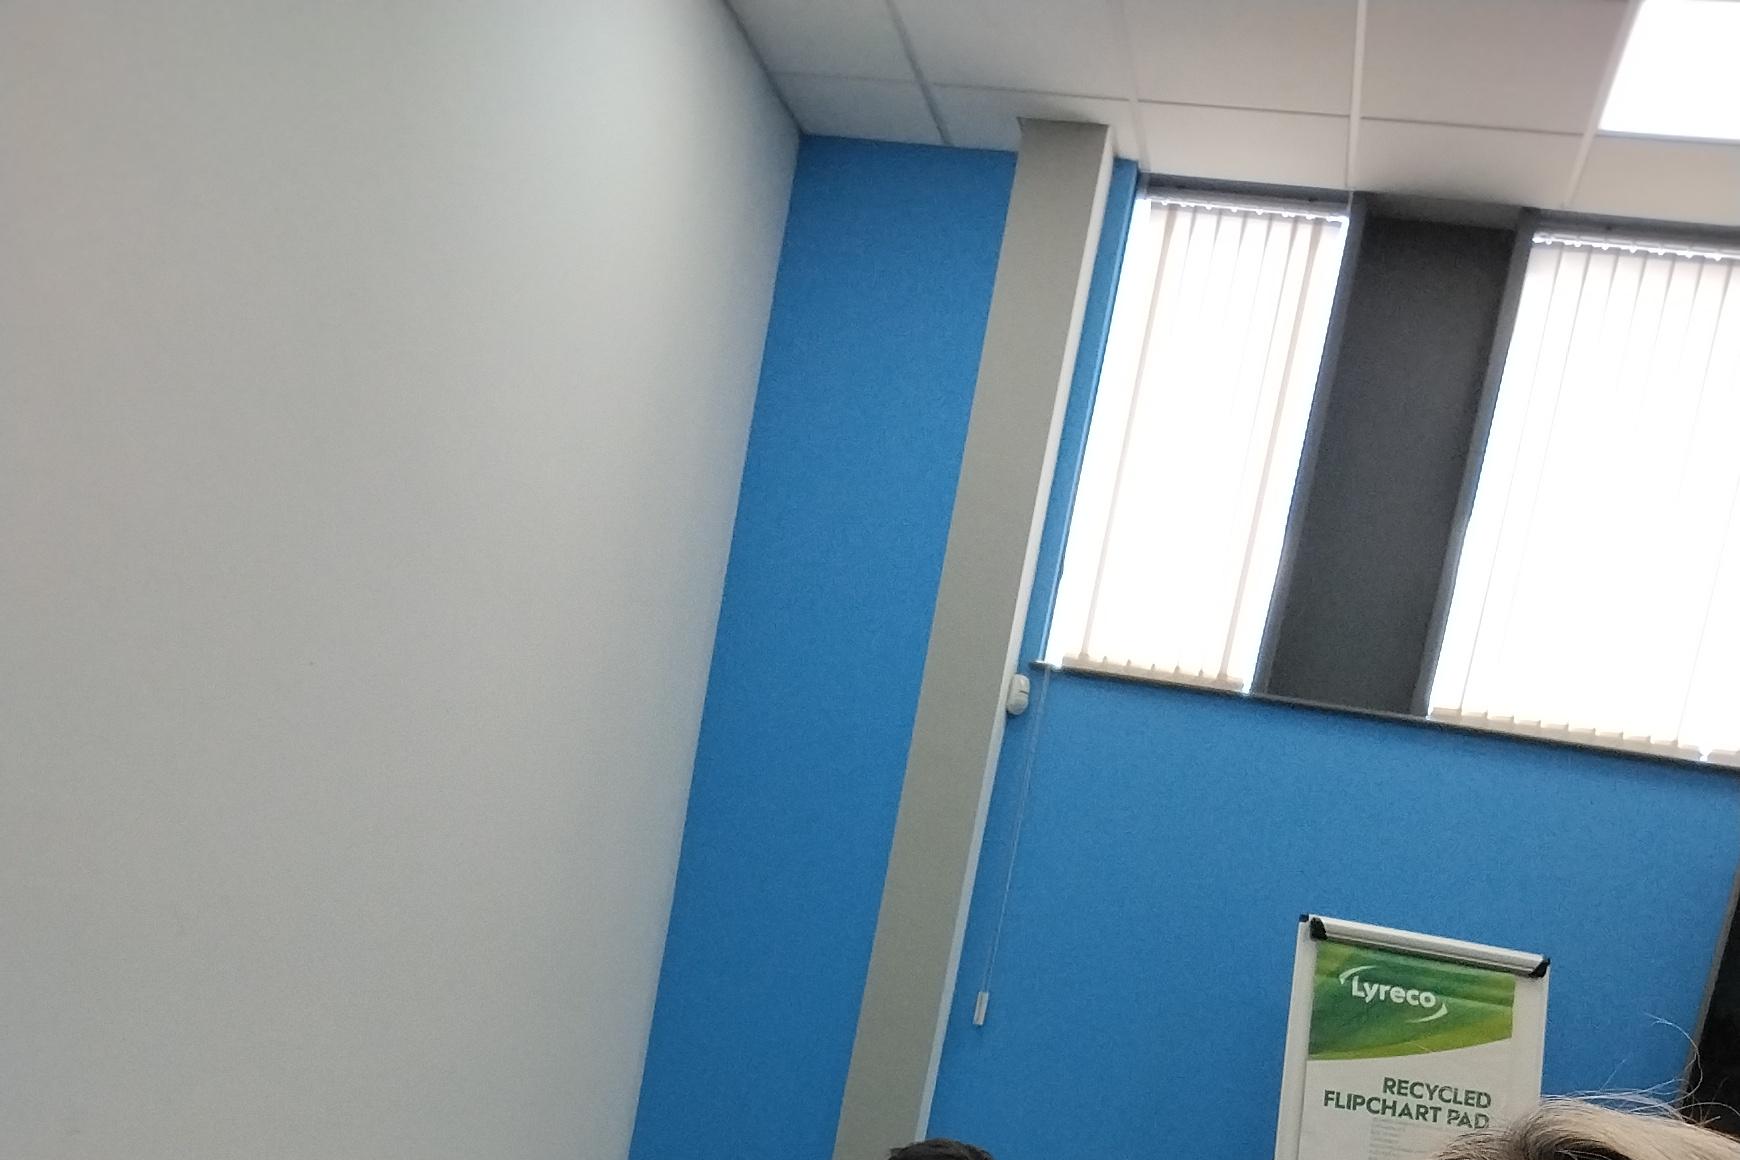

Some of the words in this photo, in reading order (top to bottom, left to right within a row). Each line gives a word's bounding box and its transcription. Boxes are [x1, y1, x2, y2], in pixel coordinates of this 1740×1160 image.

[1351, 975, 1436, 1008] Lyreco
[1383, 1076, 1491, 1108] RECYCLED
[1324, 1090, 1442, 1124] FLIPCHART
[1446, 1107, 1490, 1129] PAD
